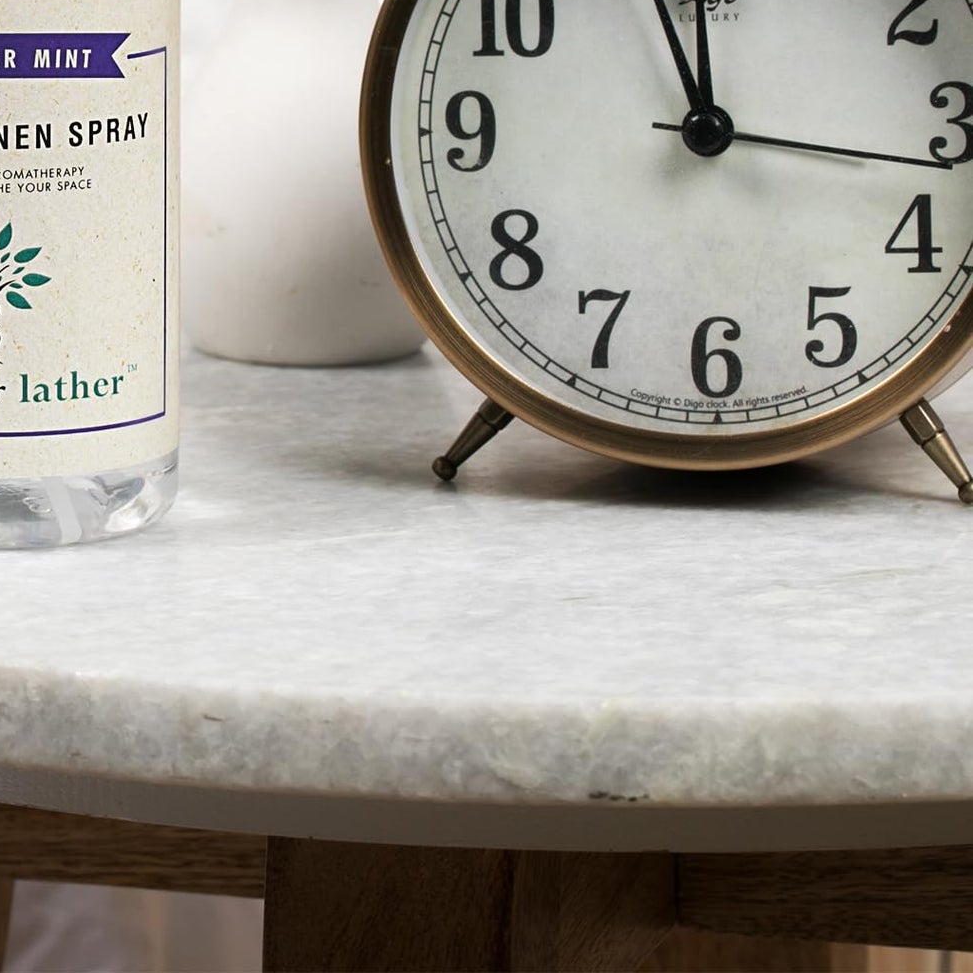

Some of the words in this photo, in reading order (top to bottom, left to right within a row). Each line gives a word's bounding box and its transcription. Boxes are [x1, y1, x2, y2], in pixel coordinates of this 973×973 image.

[679, 13, 739, 22] LUURY
[33, 48, 92, 69] MINT
[68, 112, 149, 148] SPRAY
[444, 90, 497, 172] 9
[929, 81, 973, 164] 3
[17, 182, 51, 193] YOUR
[57, 179, 92, 191] SPACE
[488, 209, 544, 291] 8
[884, 194, 943, 274] 4
[578, 288, 631, 369] 7
[690, 316, 742, 398] 6
[805, 286, 858, 368] 5
[630, 388, 671, 404] Copyright
[684, 398, 704, 410] Digo
[706, 399, 730, 408] clock.
[733, 399, 744, 407] All
[746, 396, 769, 407] rights
[771, 385, 808, 402] reserved.
